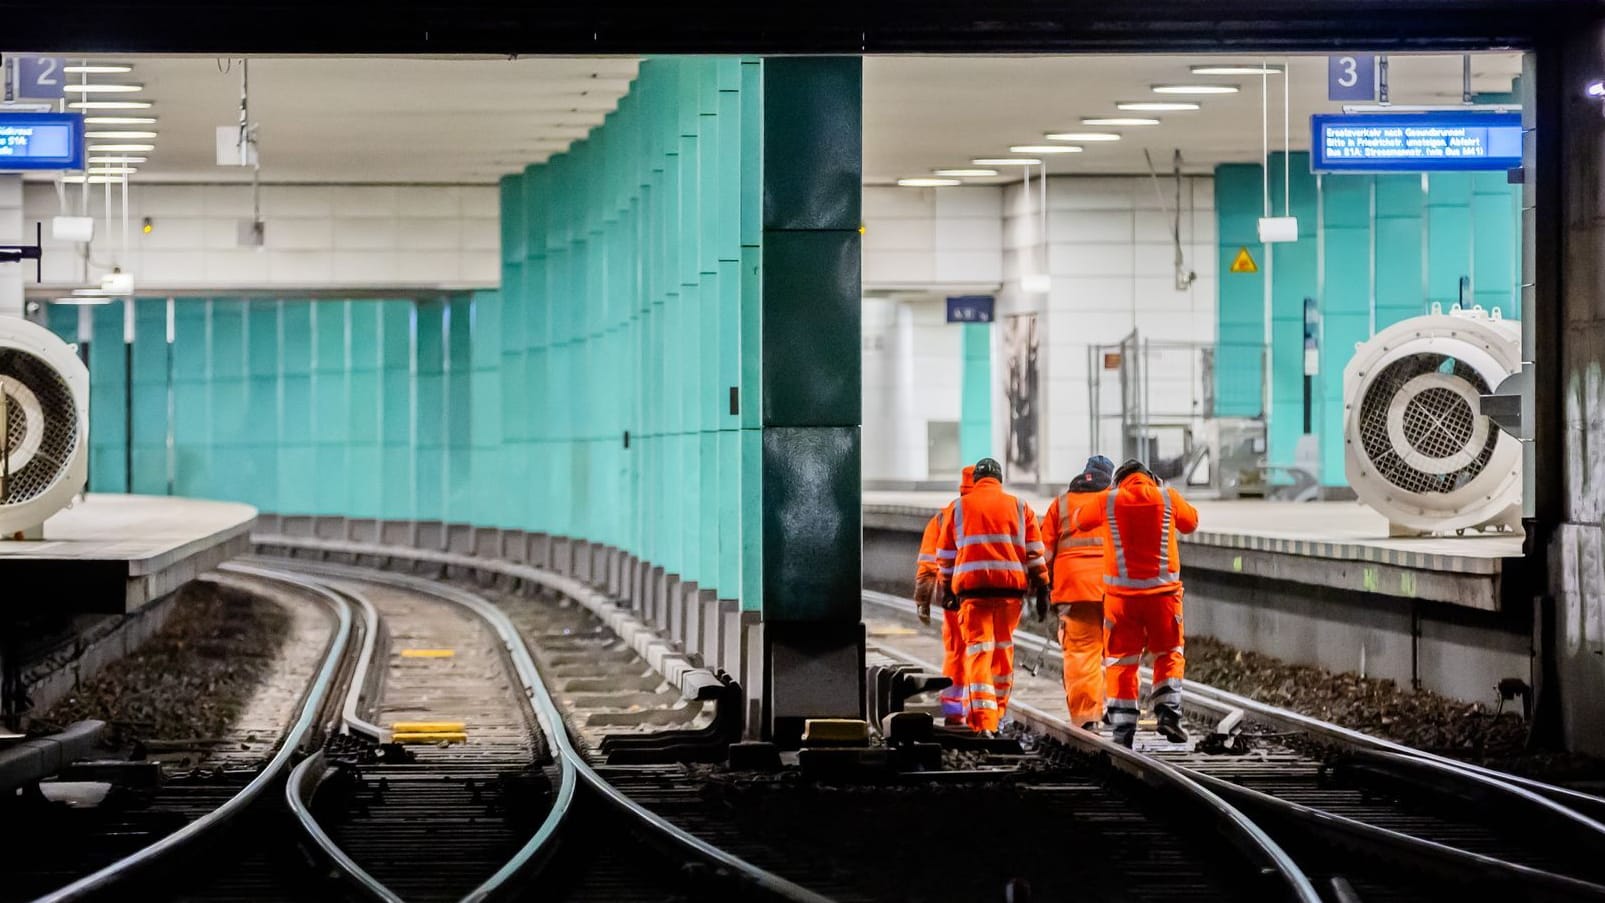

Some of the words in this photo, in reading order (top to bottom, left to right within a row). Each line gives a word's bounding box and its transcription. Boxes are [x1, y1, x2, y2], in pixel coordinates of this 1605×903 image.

[37, 57, 58, 85] 2
[1338, 56, 1358, 87] 3
[1326, 127, 1382, 137] Ersatzverkehr
[1384, 127, 1403, 137] nach
[1326, 137, 1346, 147] Bitte
[1347, 138, 1355, 147] in
[1356, 137, 1404, 147] Friedrichstr.
[1450, 137, 1480, 147] Abfahrt
[1326, 147, 1342, 156] Bus
[1445, 147, 1460, 156] Bus
[1462, 147, 1484, 156] M41)
